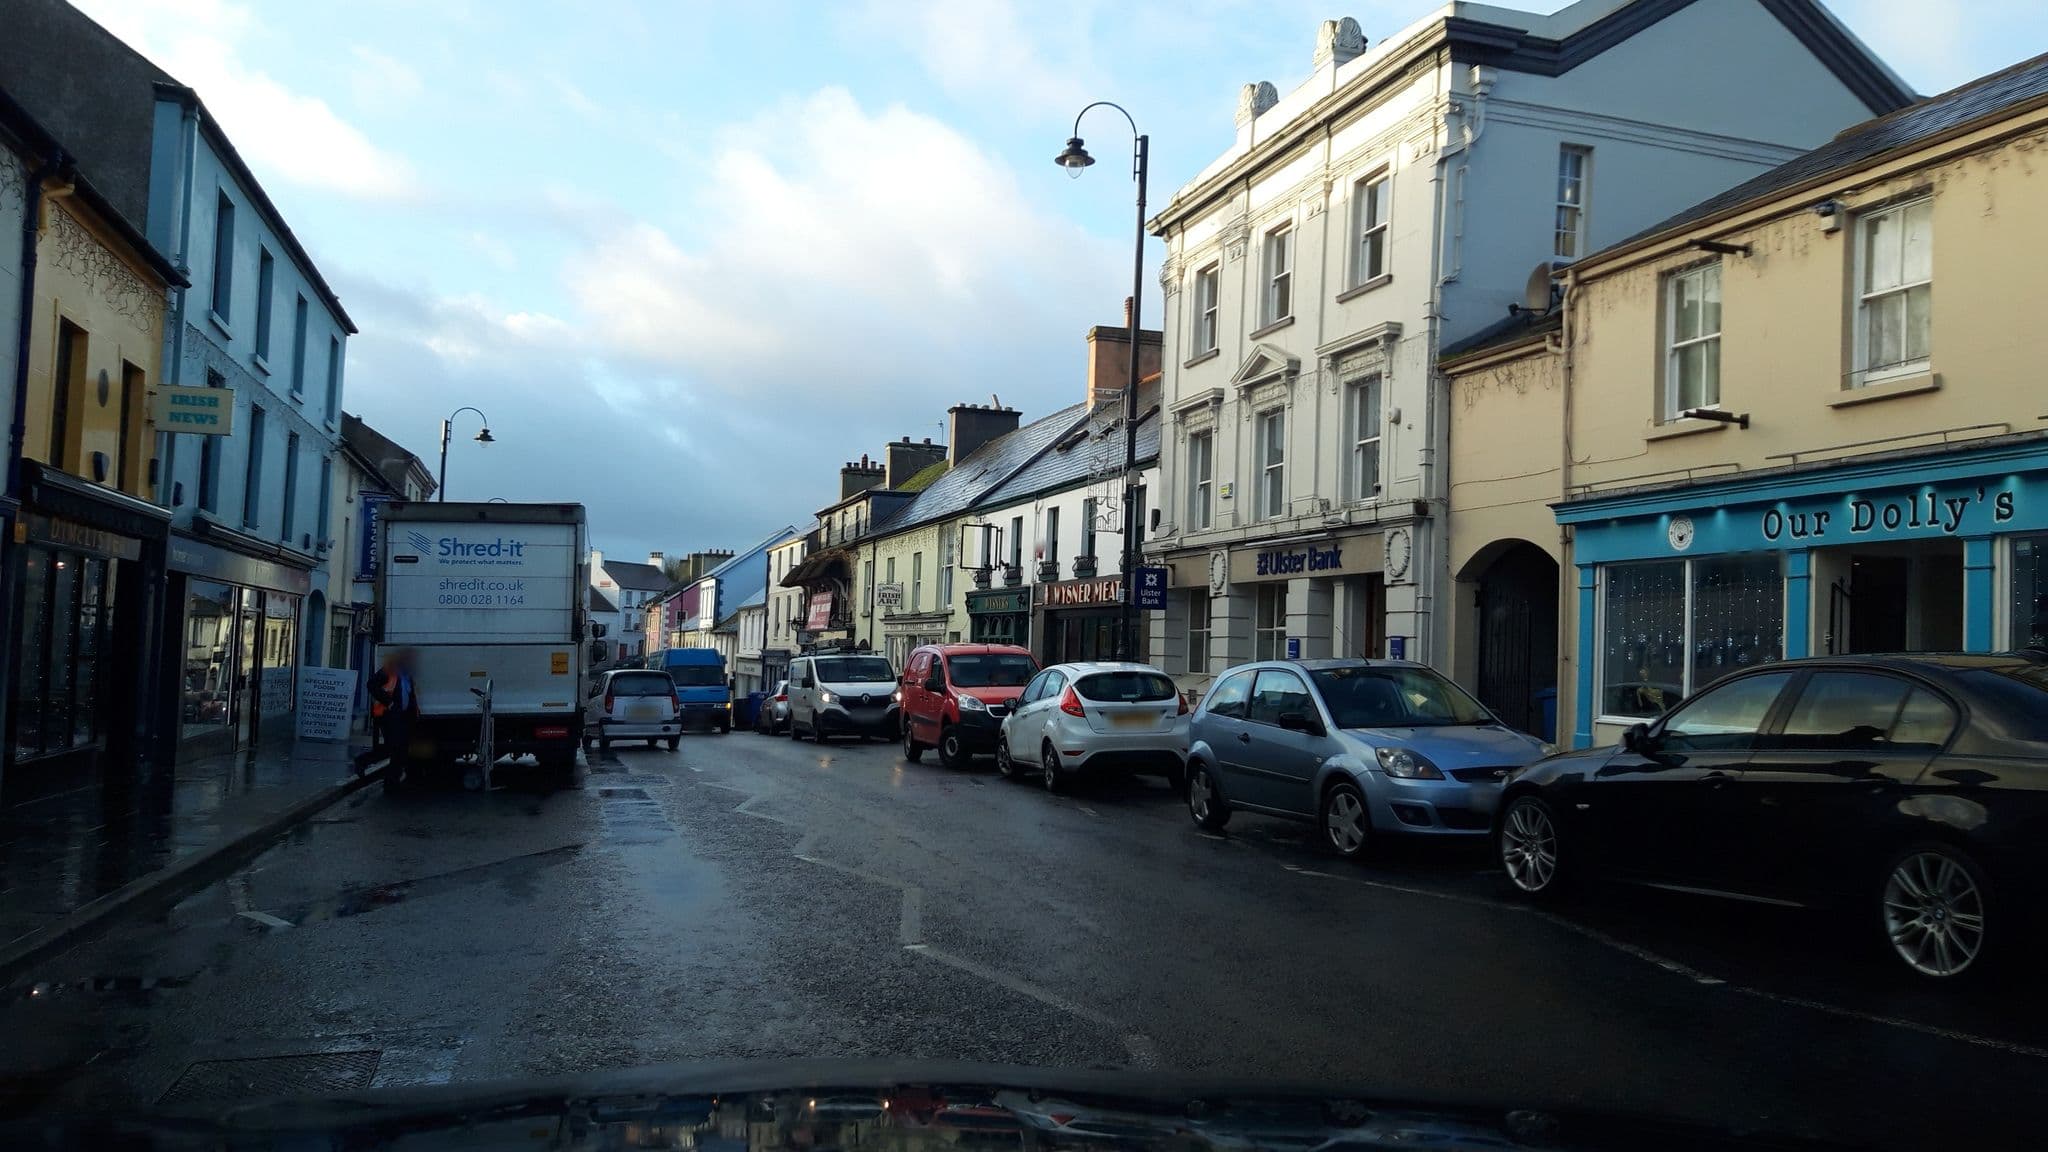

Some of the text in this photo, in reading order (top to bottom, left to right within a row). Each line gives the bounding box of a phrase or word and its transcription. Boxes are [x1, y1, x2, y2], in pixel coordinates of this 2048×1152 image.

[170, 394, 219, 408] IRISH
[169, 411, 218, 425] NEWS
[1761, 486, 2015, 541] Our Dolly's
[438, 537, 523, 557] Shred-it
[1269, 544, 1343, 575] Ulster Bank
[439, 578, 524, 591] shredit.co.uk
[438, 594, 524, 605] 0800 028 1164
[1053, 583, 1091, 605] WYSNER
[1140, 588, 1161, 597] Ulster
[1141, 597, 1160, 605] Bank
